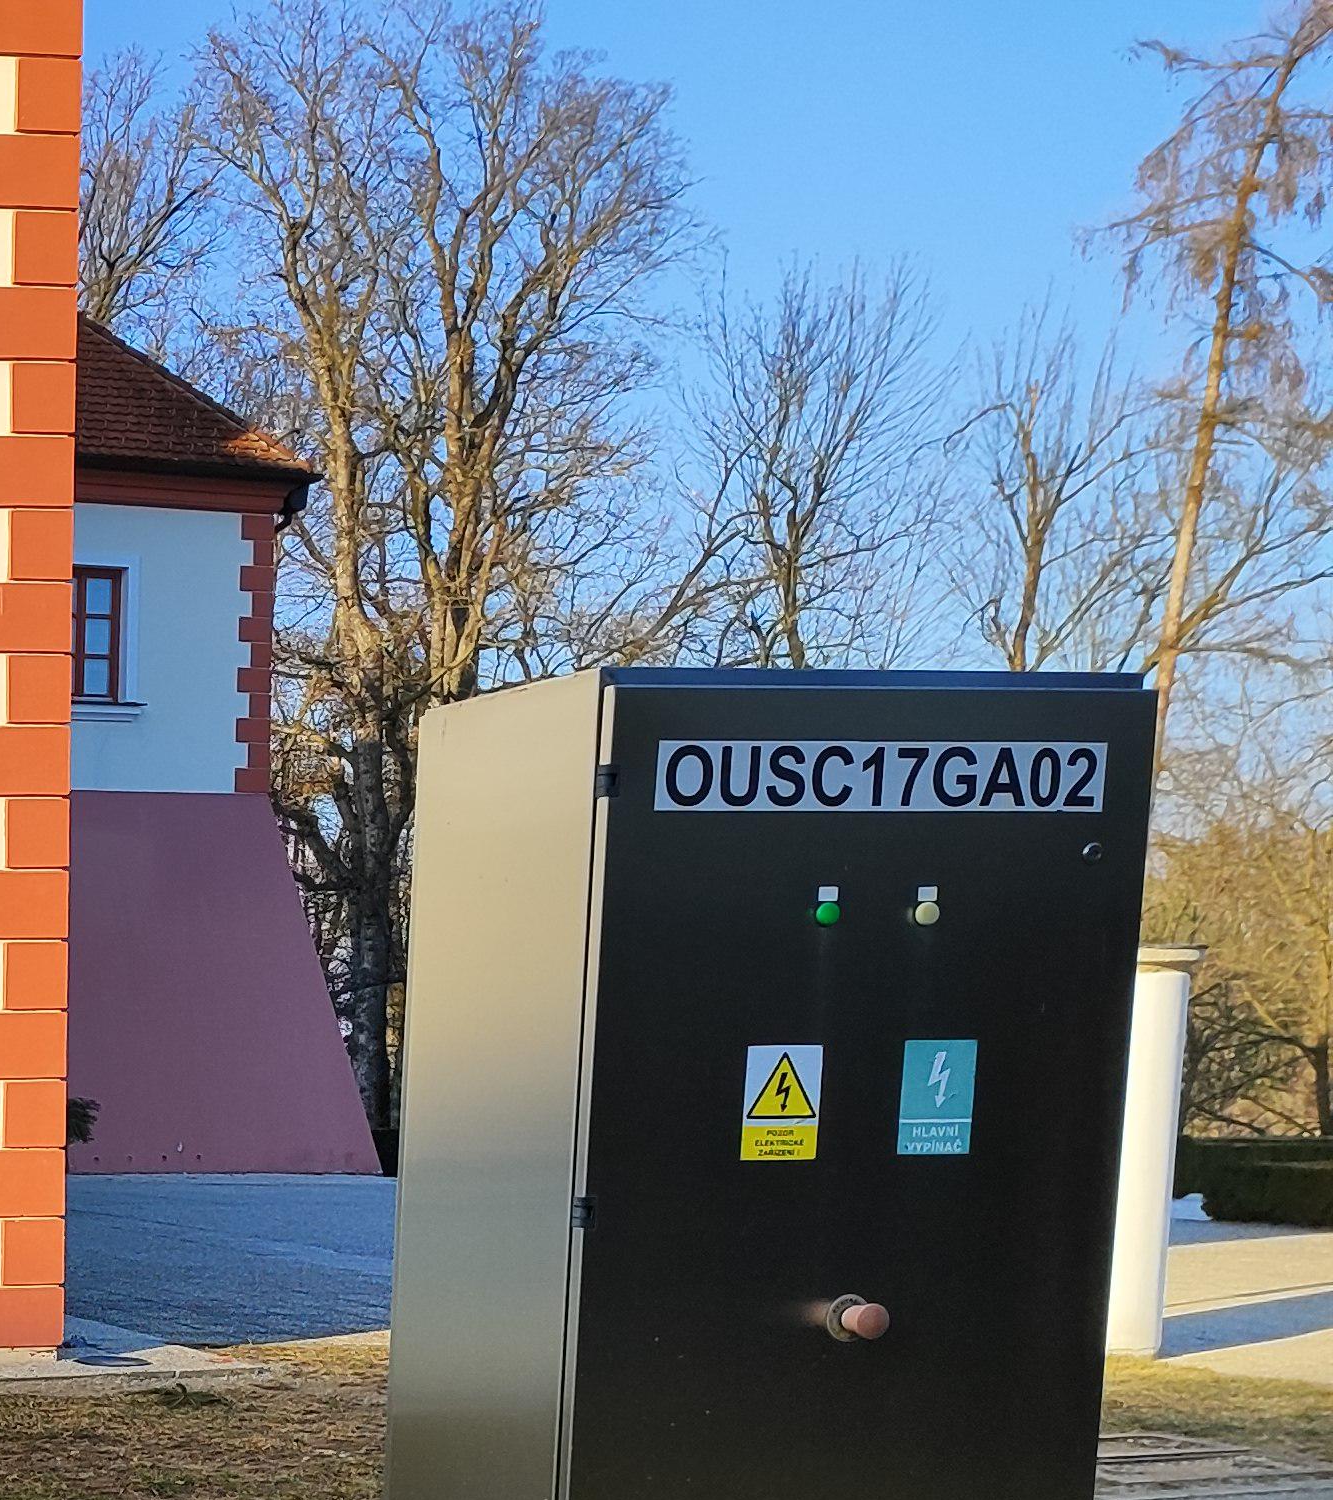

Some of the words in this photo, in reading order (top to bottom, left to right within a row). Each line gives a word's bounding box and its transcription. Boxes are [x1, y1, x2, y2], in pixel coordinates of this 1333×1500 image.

[665, 744, 1097, 808] OUSC17GA02
[766, 1129, 794, 1137] POZOR
[912, 1124, 959, 1137] HLAVNÍ
[906, 1139, 962, 1152] VYPÍNAČ
